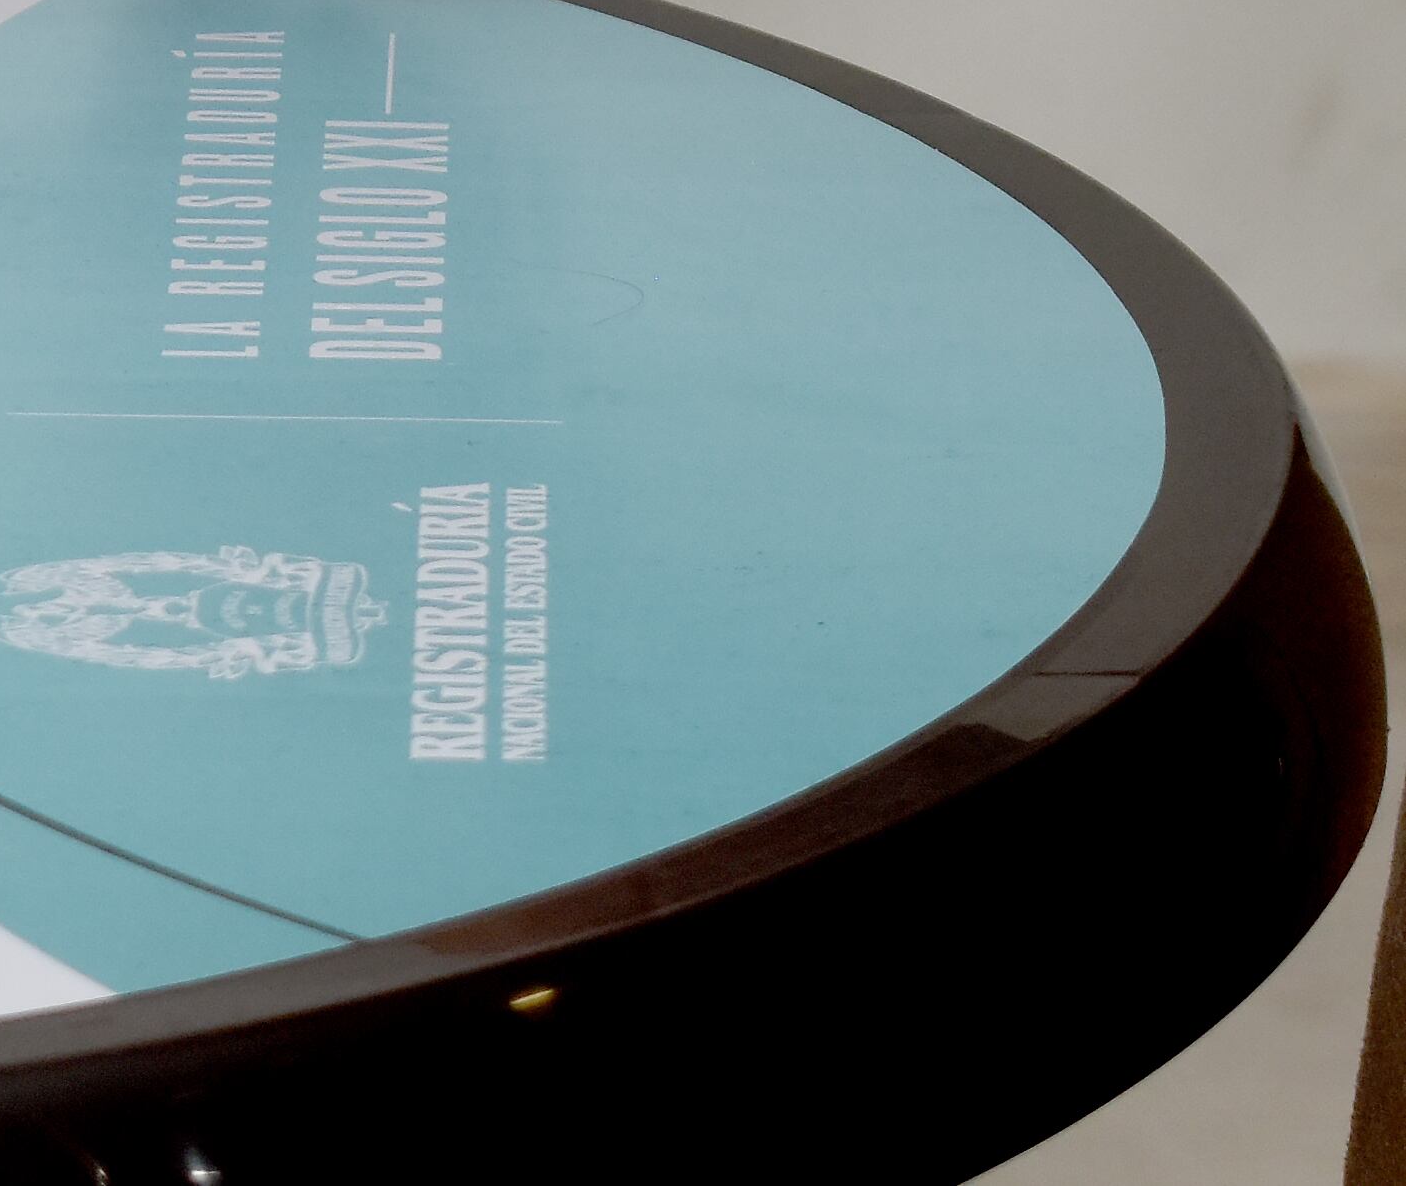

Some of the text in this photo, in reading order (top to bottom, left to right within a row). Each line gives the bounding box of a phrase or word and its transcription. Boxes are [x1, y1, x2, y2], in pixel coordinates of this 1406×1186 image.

[160, 30, 286, 359] LA REGISTRADURÍA
[308, 120, 451, 360] DEL SIGLO XXI
[391, 482, 490, 760] REGISTRADURÍA
[501, 484, 548, 760] NACIONAL DEL ESTADO CIVIL
